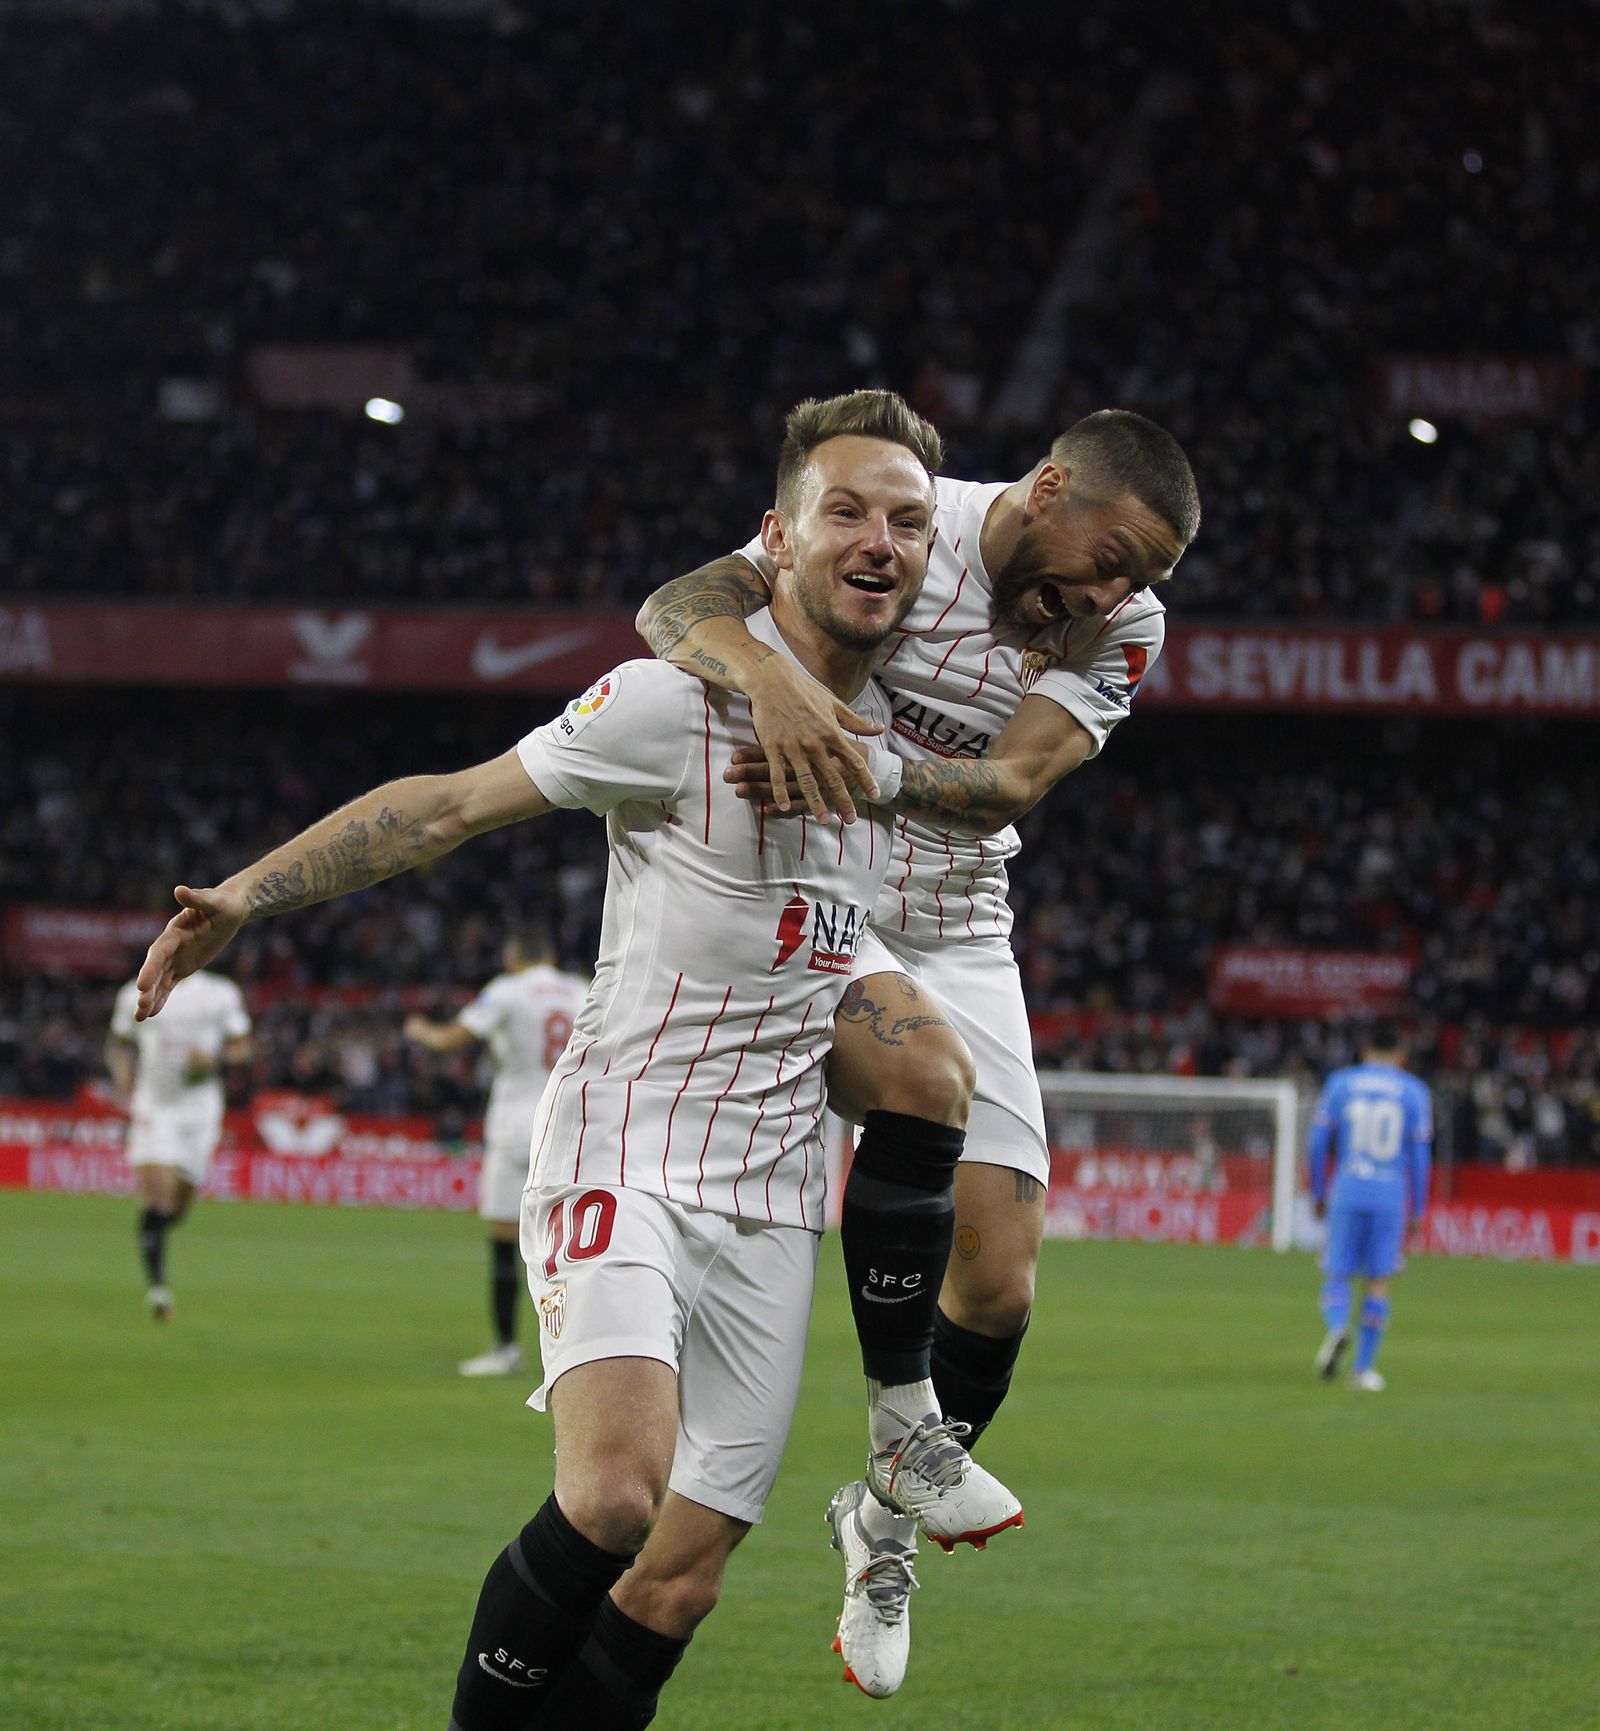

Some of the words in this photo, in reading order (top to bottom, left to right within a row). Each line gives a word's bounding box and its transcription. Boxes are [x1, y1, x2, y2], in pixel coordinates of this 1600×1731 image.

[1186, 634, 1437, 704] SEVILLA
[1456, 641, 1600, 710] CAM
[814, 956, 831, 968] Your
[1345, 1098, 1404, 1162] 10
[542, 1189, 618, 1281] 10
[868, 1267, 922, 1289] SFC
[494, 1647, 548, 1680] SFC
